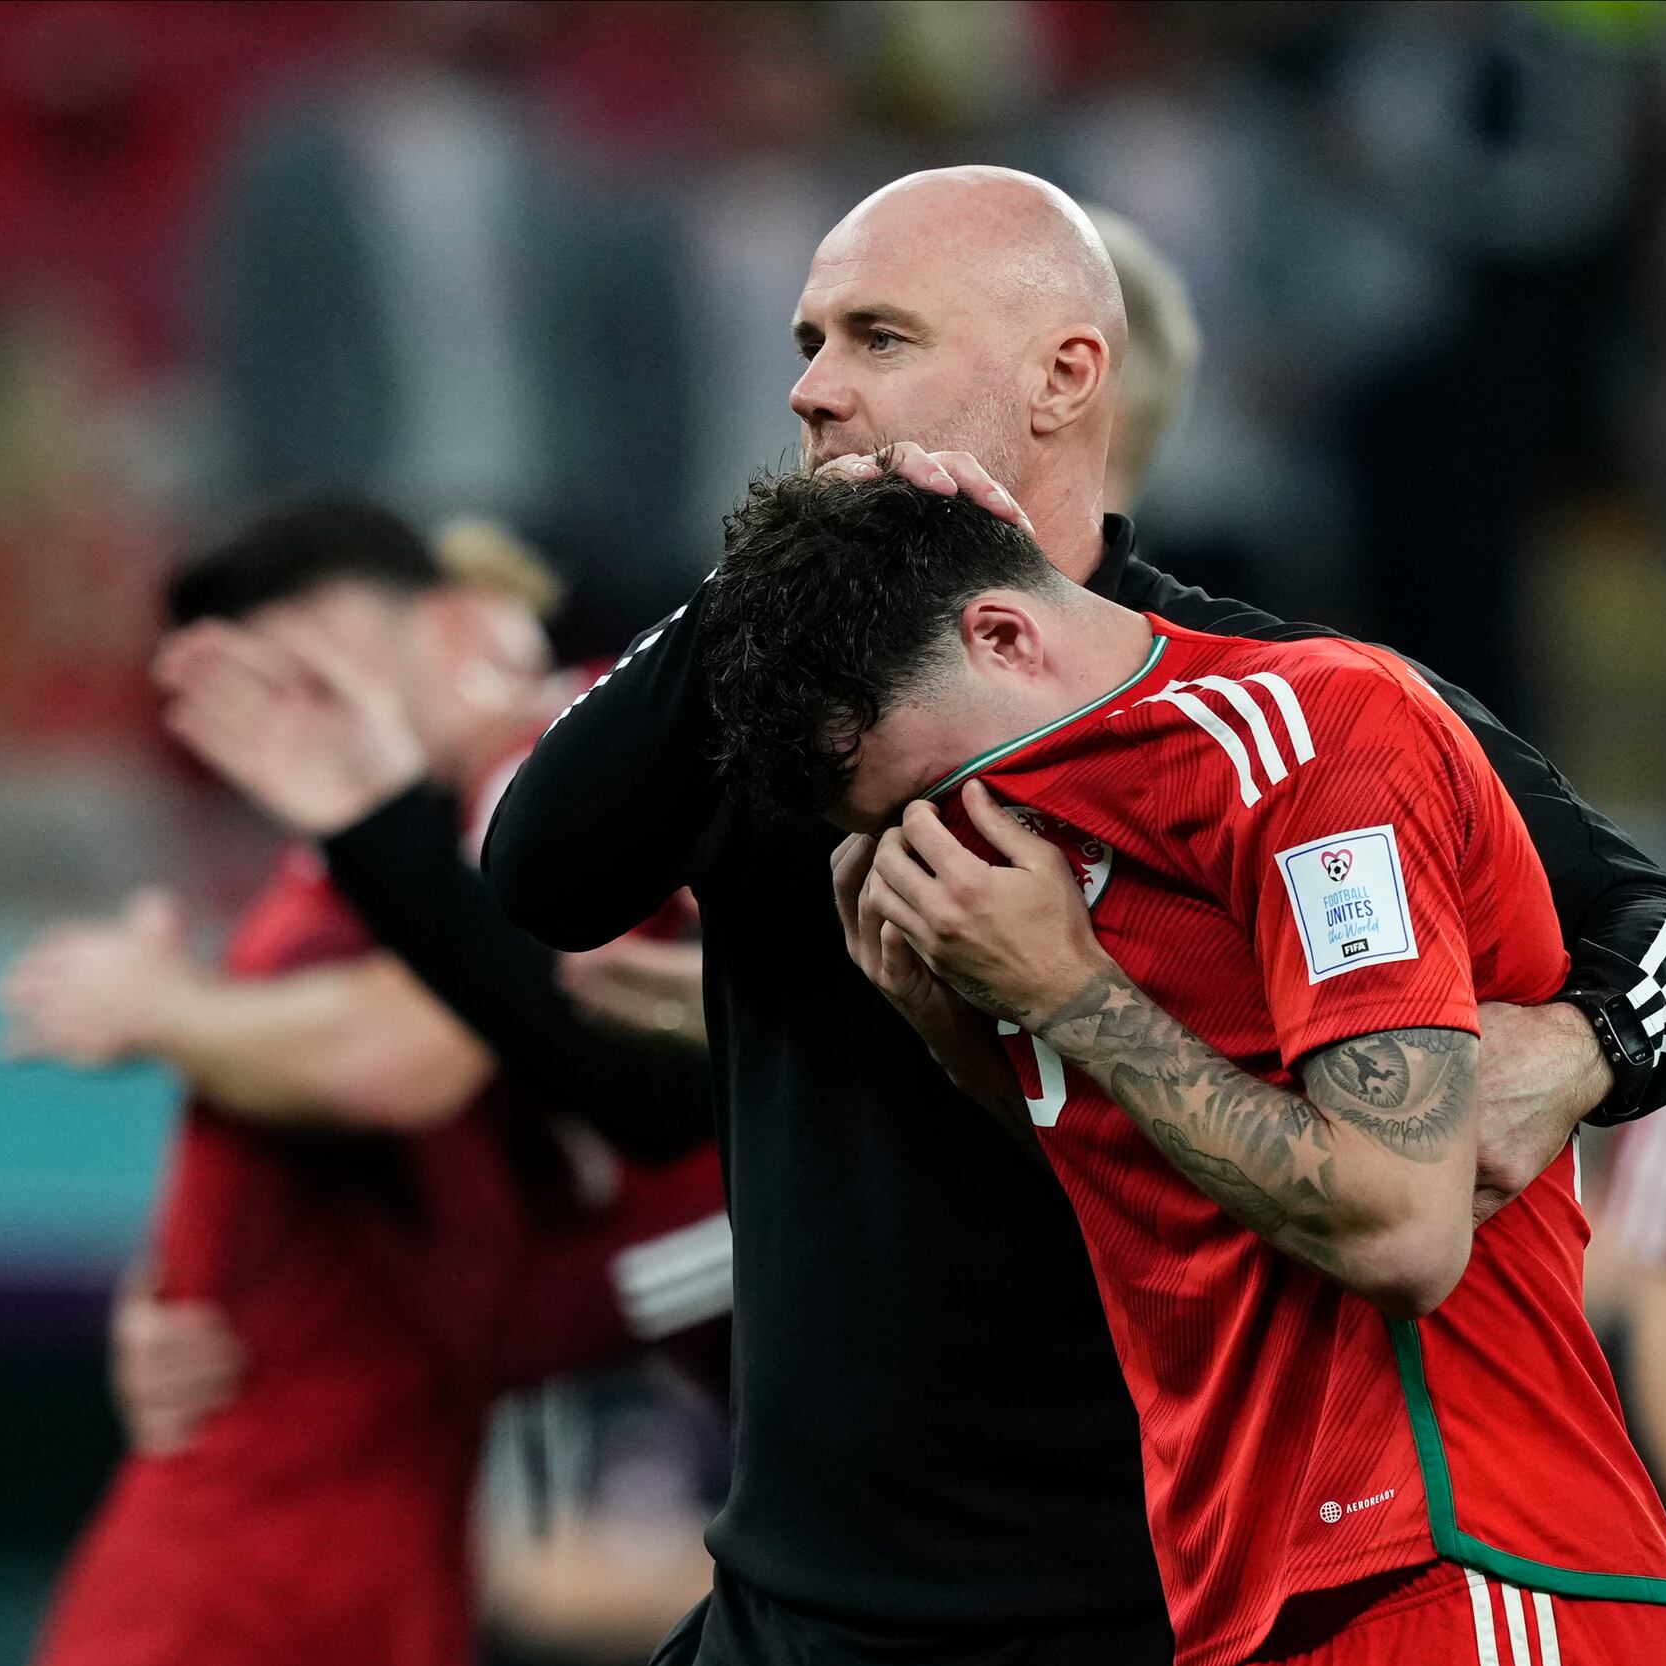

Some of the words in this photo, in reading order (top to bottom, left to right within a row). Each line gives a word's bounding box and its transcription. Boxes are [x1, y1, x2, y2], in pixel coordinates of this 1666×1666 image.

[1324, 887, 1370, 909] FOOTBALL
[1326, 900, 1373, 927] UNITES
[1328, 930, 1343, 944] the
[1343, 919, 1379, 938] World
[1344, 941, 1367, 955] FIFA
[1346, 1488, 1395, 1514] AEROREADY
